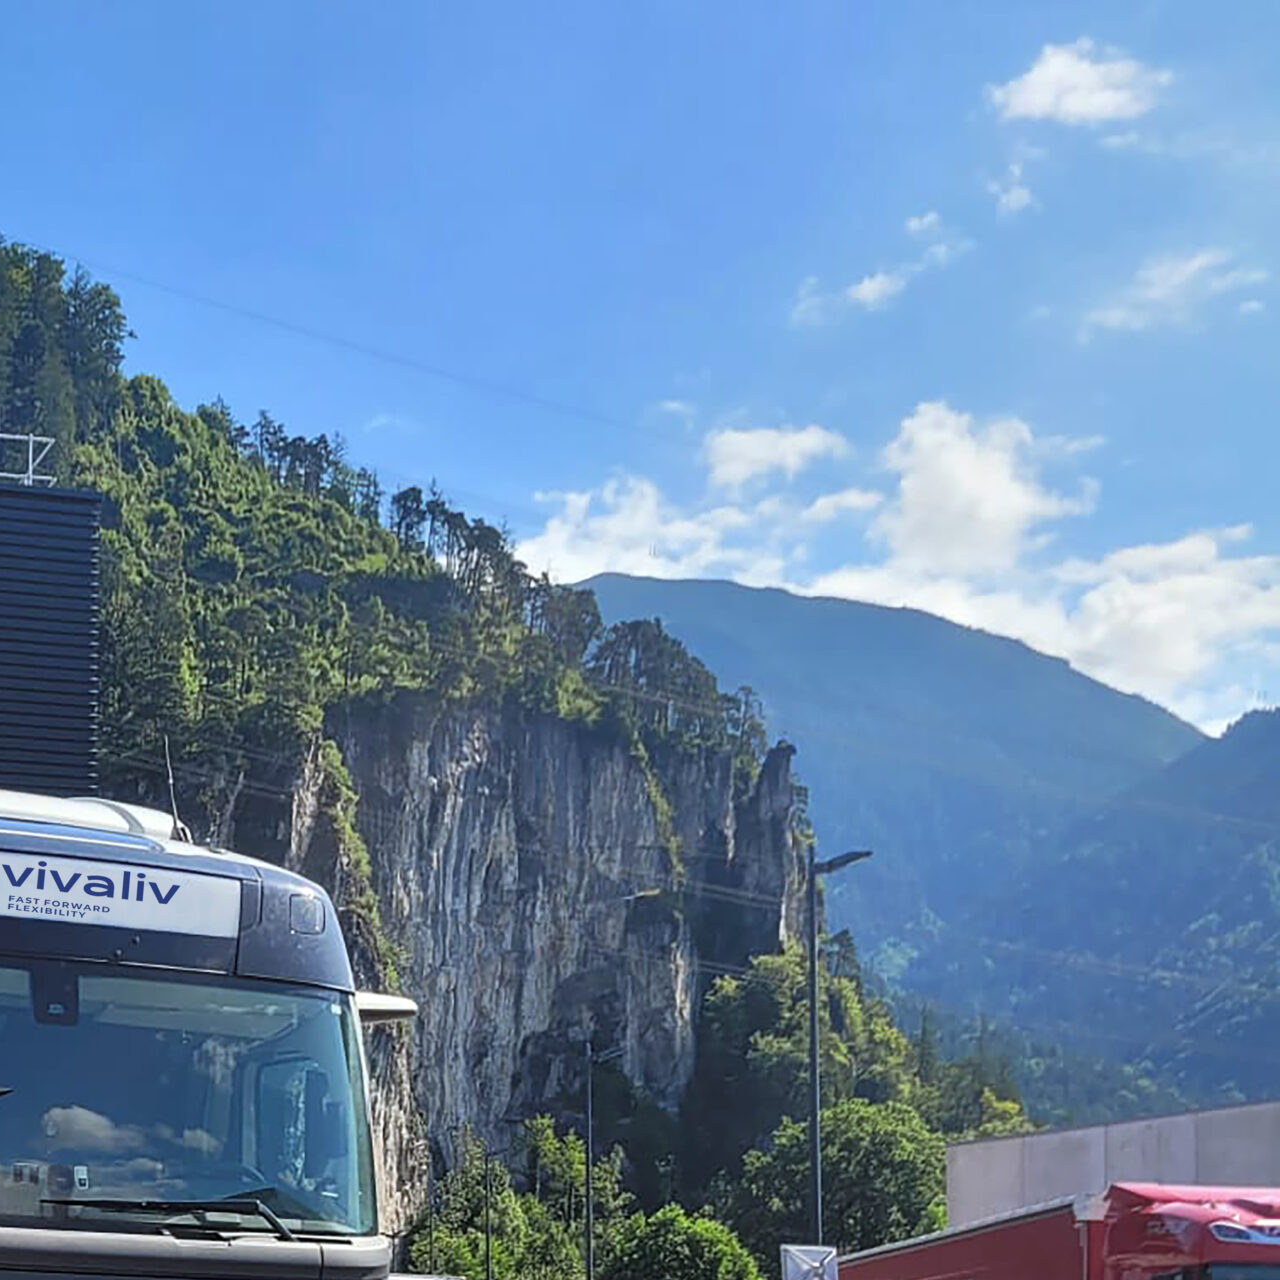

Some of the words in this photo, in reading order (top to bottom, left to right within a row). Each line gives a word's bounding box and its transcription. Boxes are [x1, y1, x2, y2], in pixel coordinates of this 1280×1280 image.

[2, 861, 181, 905] vivaliv
[7, 903, 86, 919] FLEXIBILITY
[8, 895, 41, 905] FAST
[44, 900, 111, 914] FORWARD
